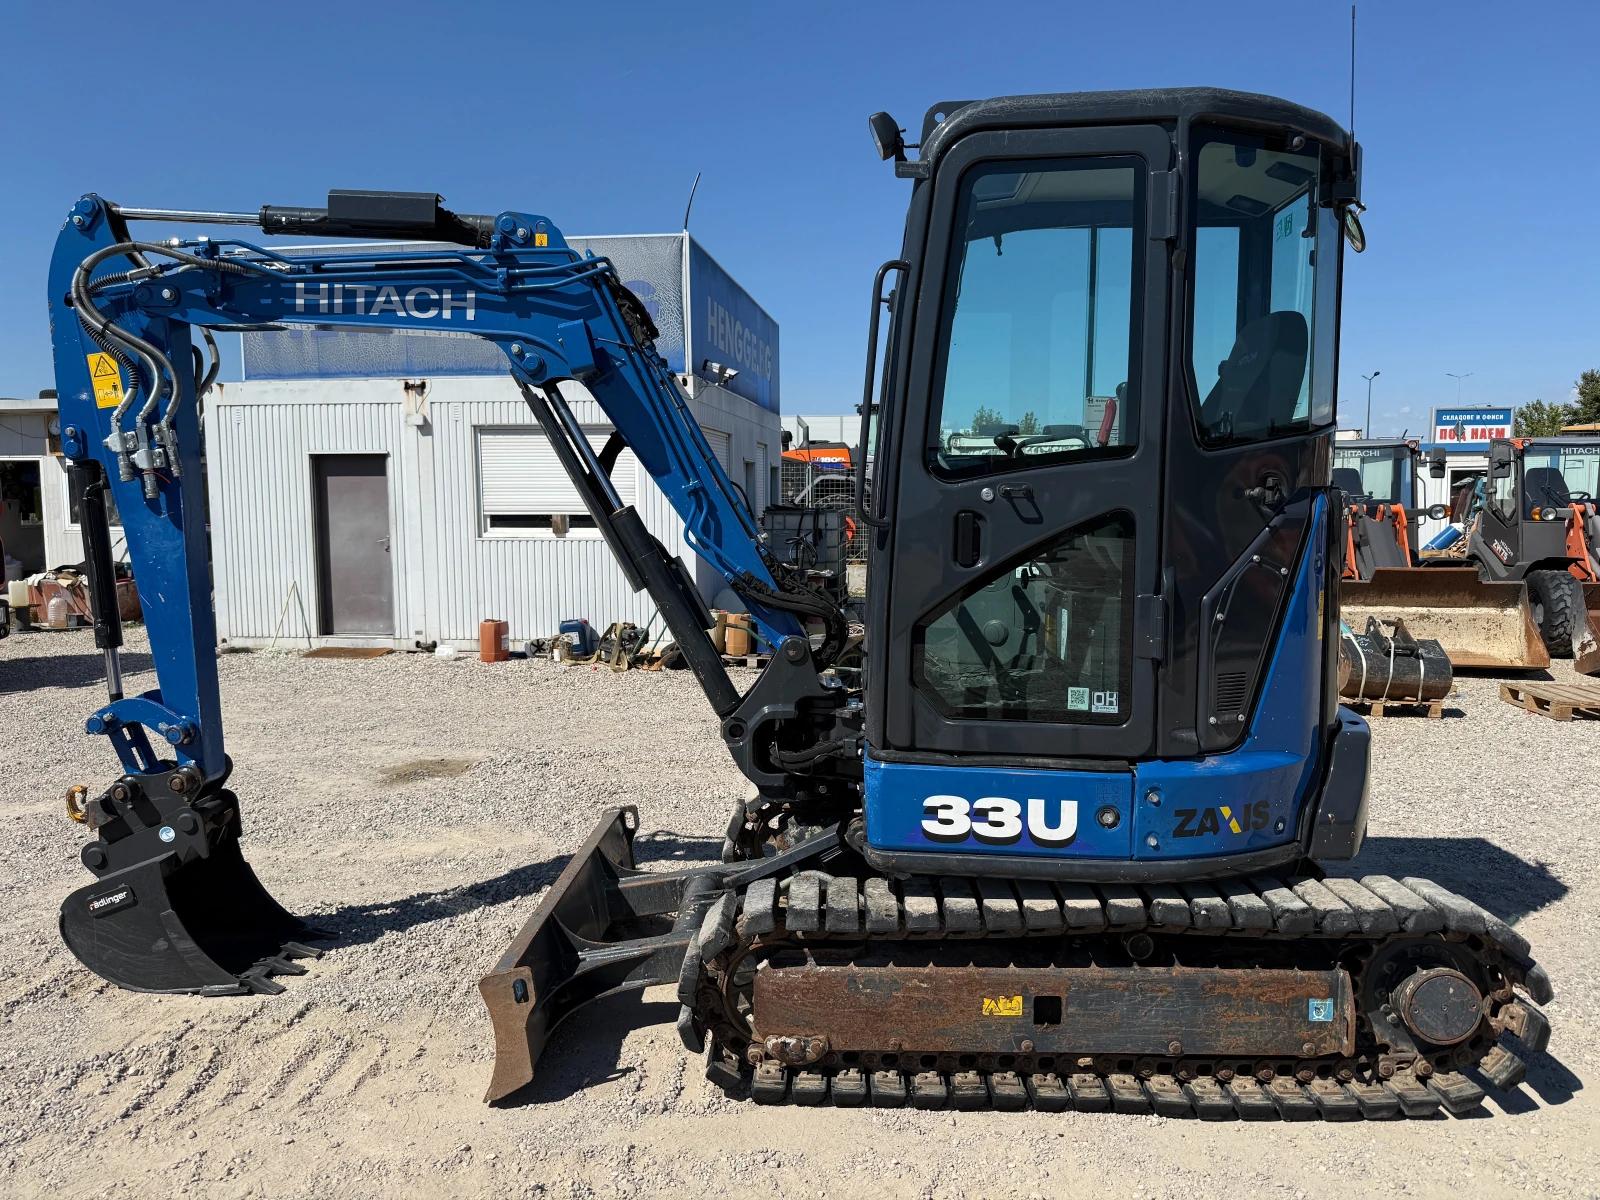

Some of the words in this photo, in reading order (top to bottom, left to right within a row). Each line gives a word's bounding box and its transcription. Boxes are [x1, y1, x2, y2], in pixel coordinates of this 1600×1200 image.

[295, 282, 476, 321] HITACH
[707, 295, 772, 382] HENGGE.BG
[1471, 427, 1506, 440] НАЕМ
[1093, 690, 1117, 706] OK
[921, 795, 1078, 848] 33U
